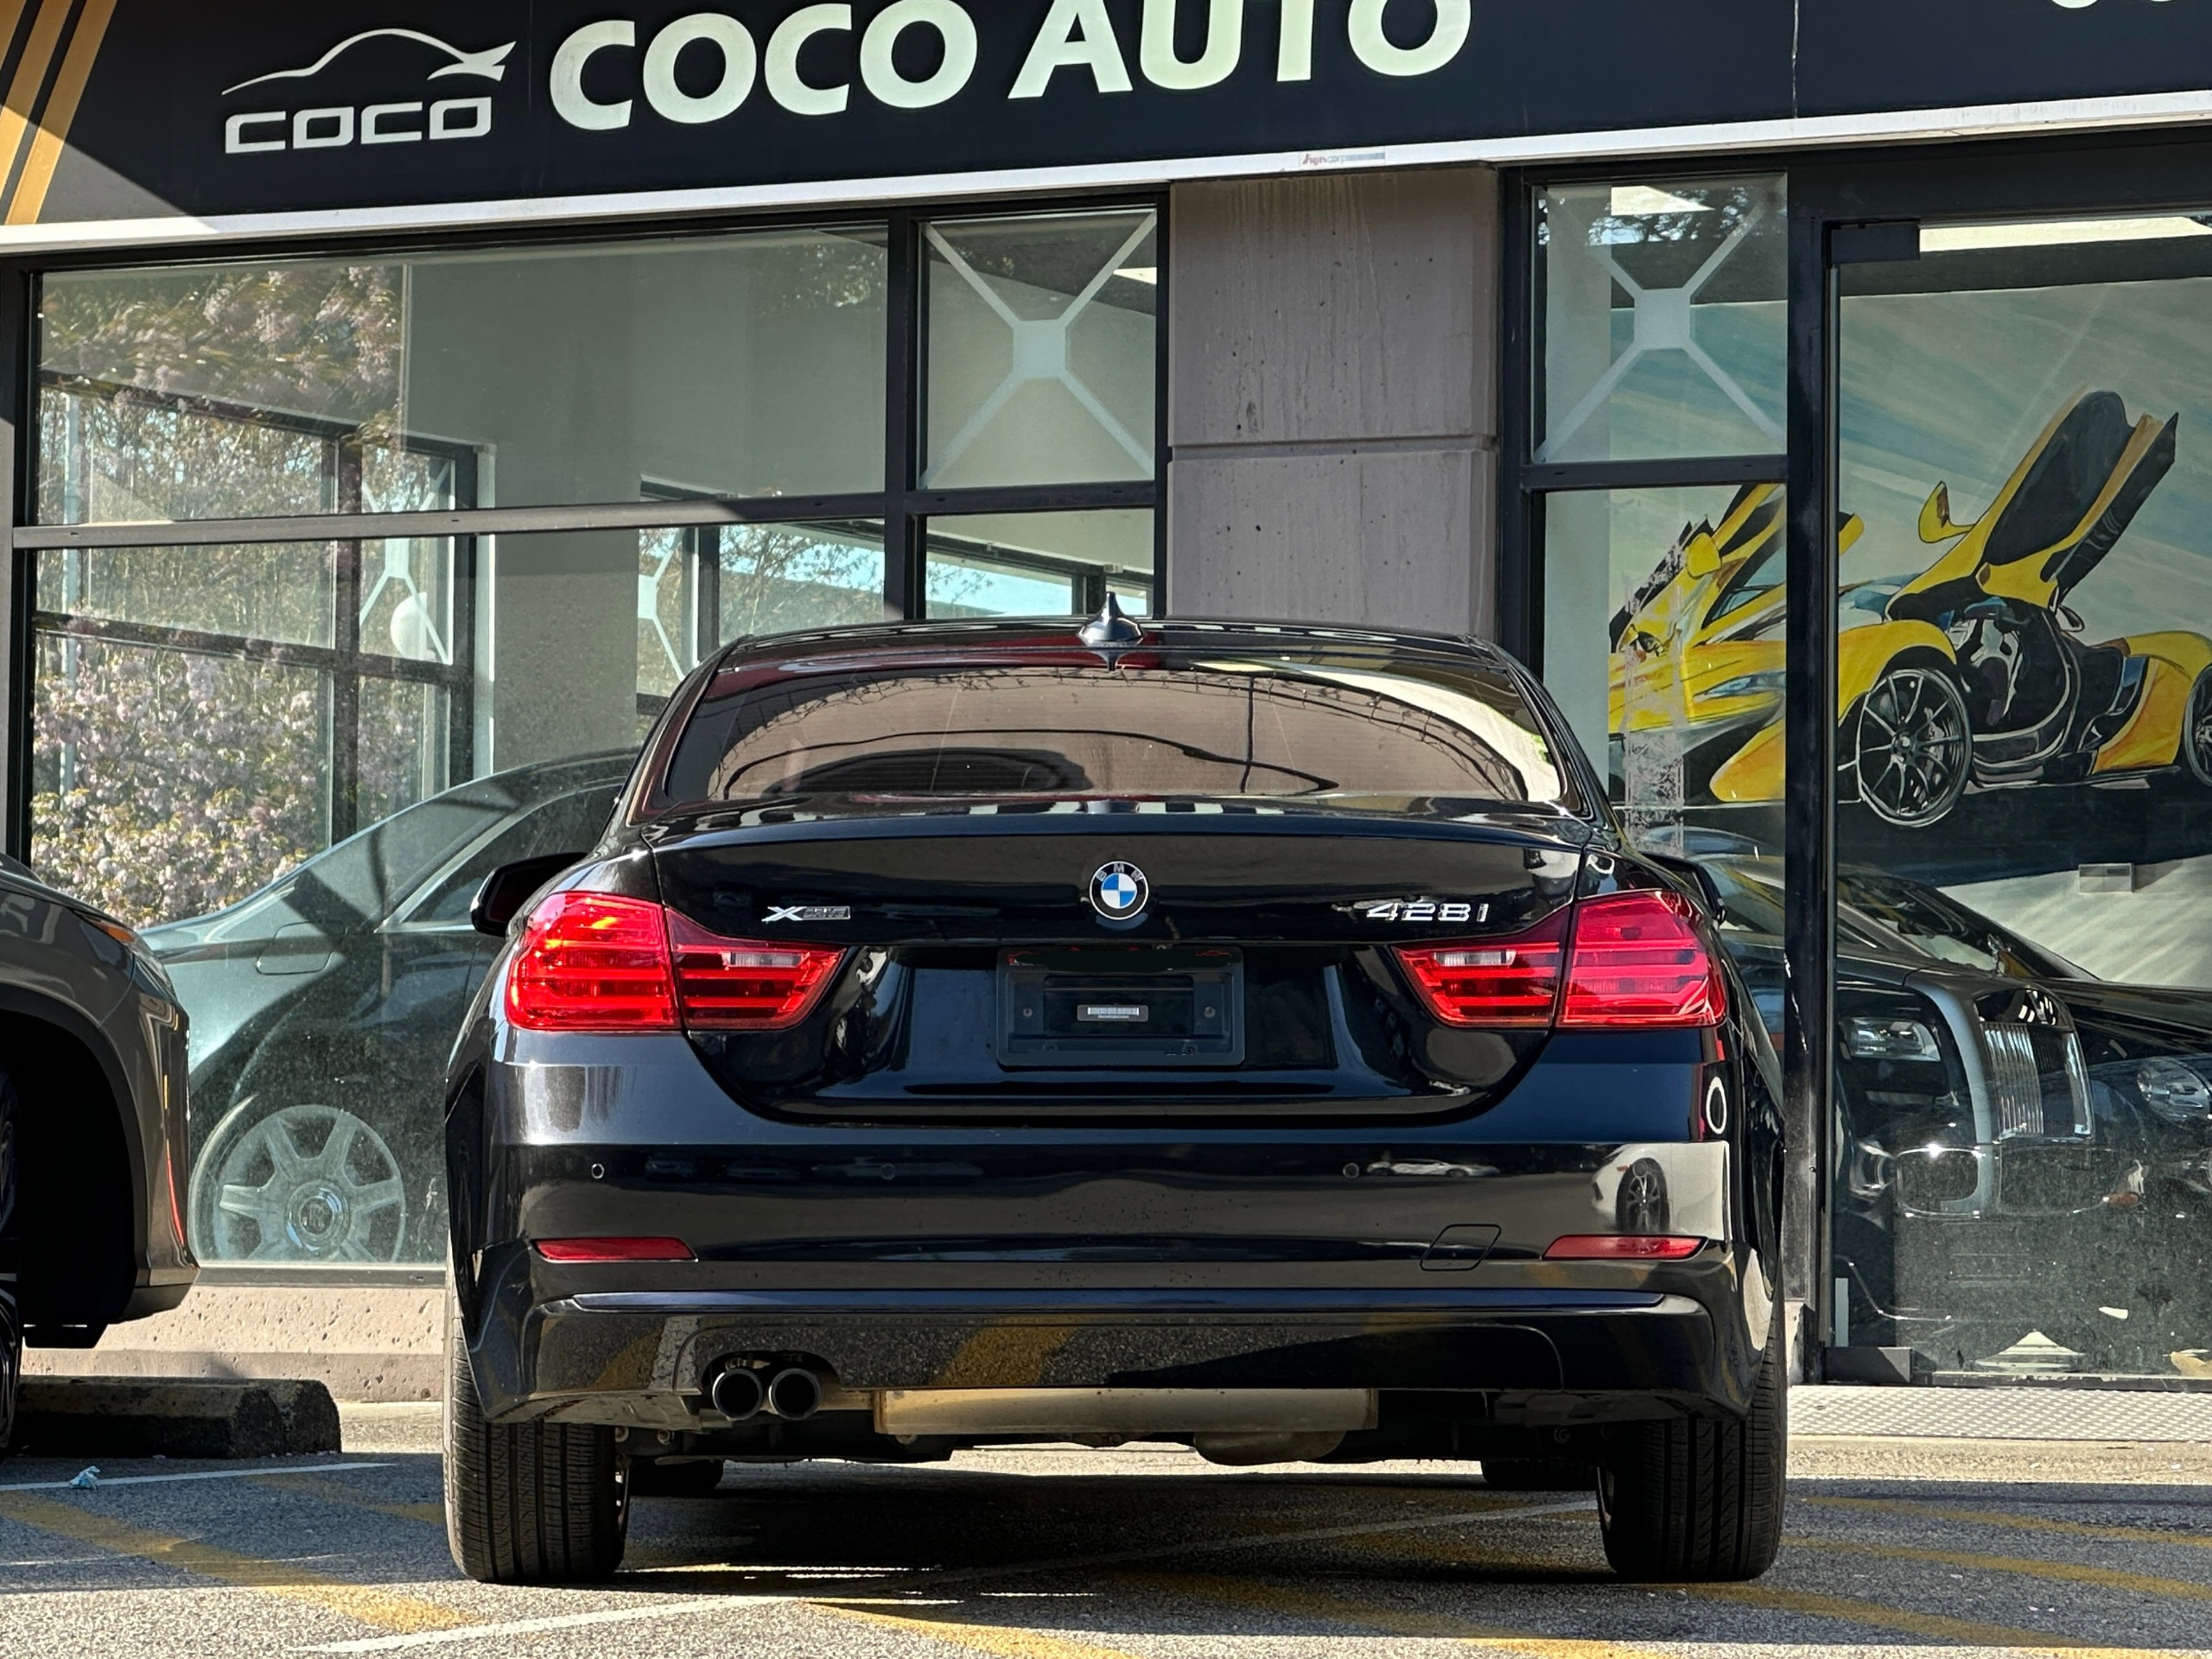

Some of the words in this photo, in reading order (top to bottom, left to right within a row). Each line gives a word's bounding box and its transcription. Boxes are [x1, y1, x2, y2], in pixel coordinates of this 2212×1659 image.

[550, 0, 978, 130] COCO
[1007, 0, 1471, 99] AUTO
[225, 96, 492, 154] COCO
[1095, 862, 1143, 882] BMW
